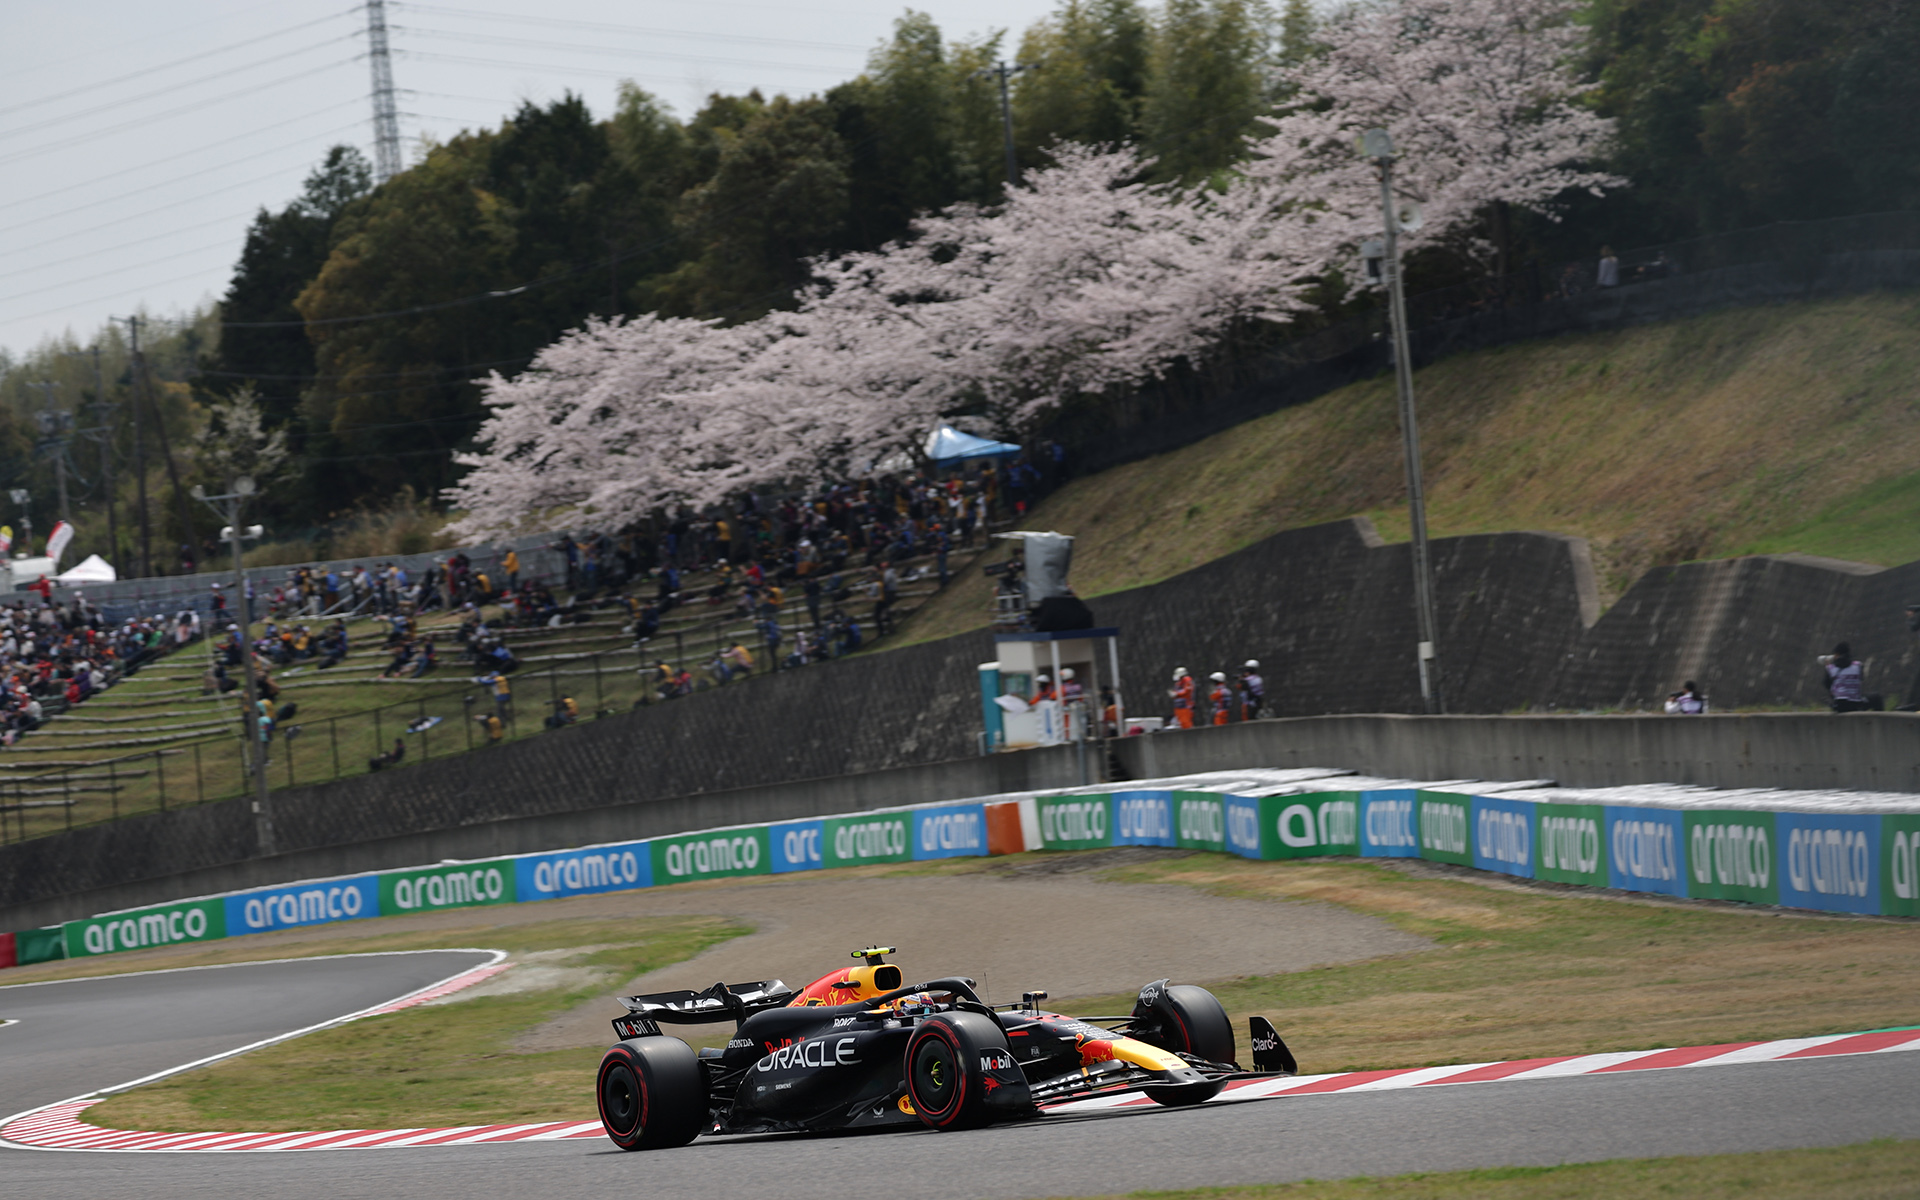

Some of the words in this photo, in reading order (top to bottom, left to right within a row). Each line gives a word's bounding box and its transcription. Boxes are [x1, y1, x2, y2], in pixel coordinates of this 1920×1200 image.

[665, 836, 760, 876] aramco
[835, 820, 906, 859] aramco
[1691, 824, 1770, 888] aramco
[534, 851, 638, 892] aramco
[1788, 828, 1869, 897] aramco
[244, 886, 362, 928] aramco
[394, 868, 502, 909] aramco
[84, 908, 207, 953] aramco
[615, 1020, 649, 1037] Mobil
[728, 1038, 755, 1049] HONDA
[1252, 1036, 1275, 1051] Claro
[757, 1037, 862, 1072] ORACLE
[980, 1055, 1012, 1070] Mobil
[1031, 1048, 1040, 1056] FIA
